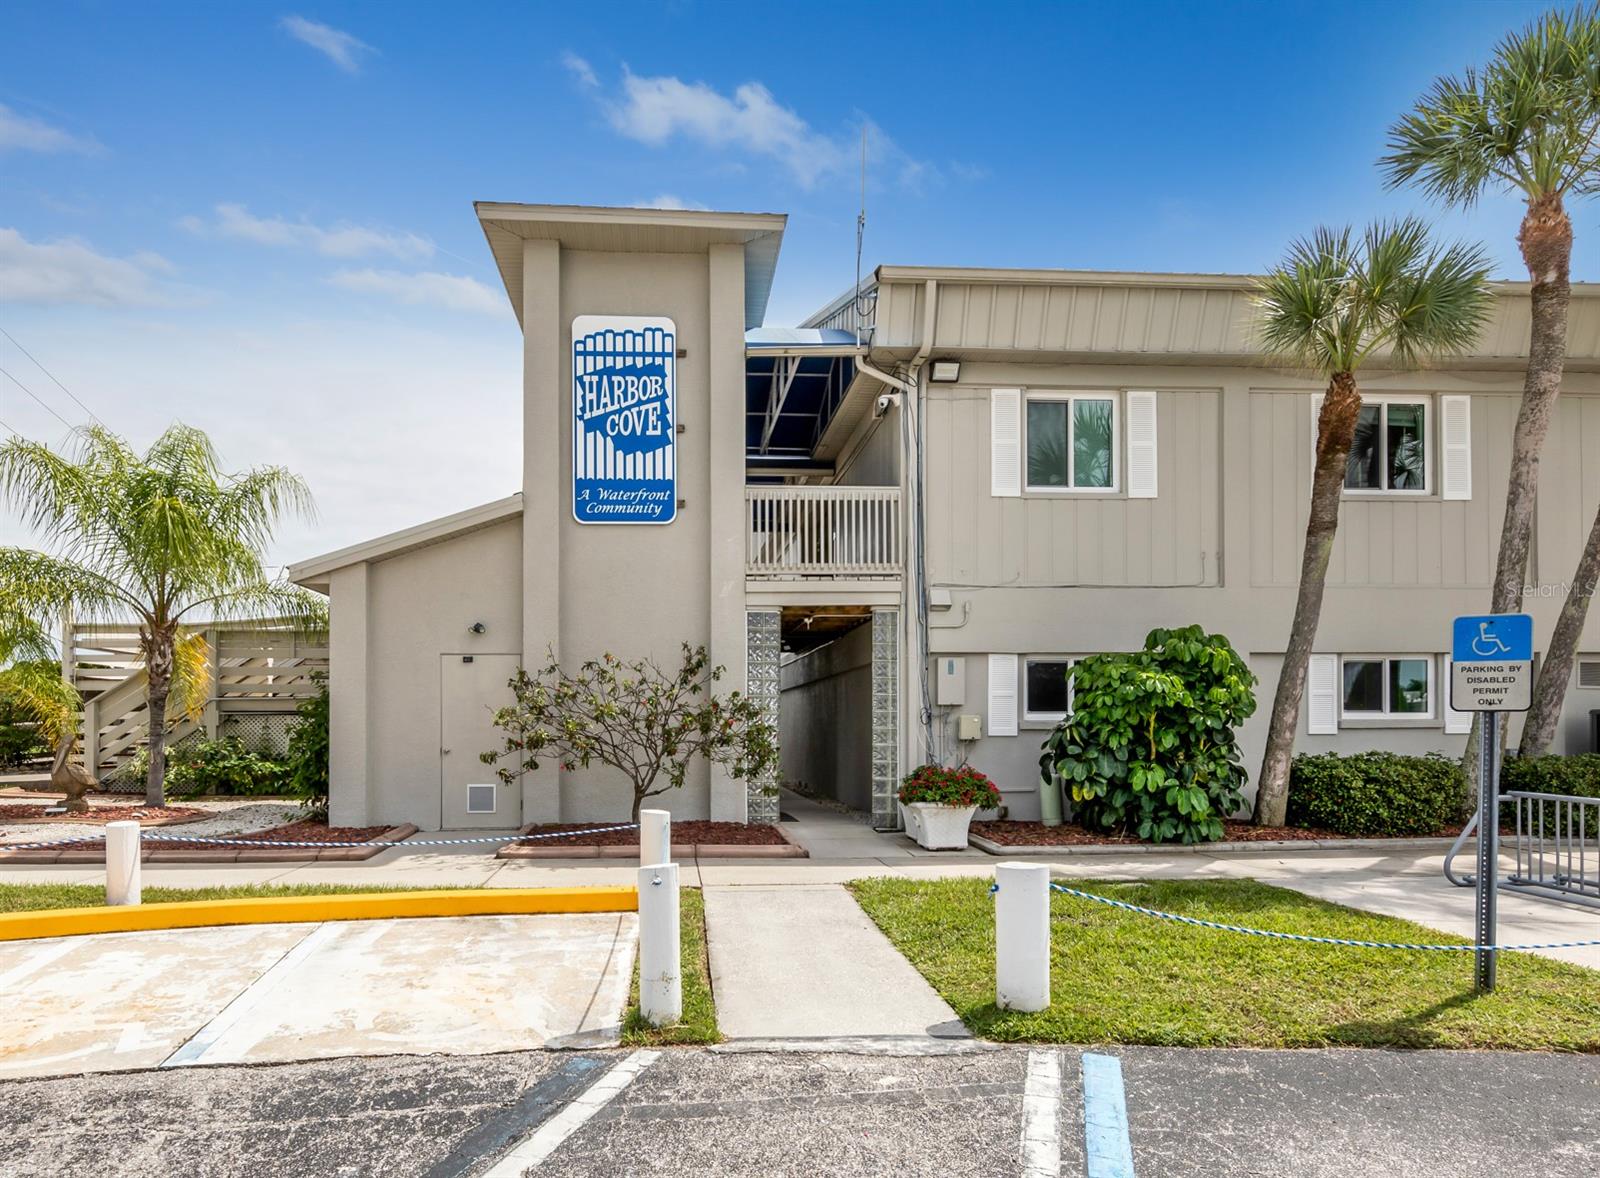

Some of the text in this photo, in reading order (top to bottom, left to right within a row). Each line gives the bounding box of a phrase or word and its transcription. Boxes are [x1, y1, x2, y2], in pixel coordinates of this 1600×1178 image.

[583, 375, 664, 420] HARBOR
[606, 401, 662, 436] COVE
[577, 487, 671, 504] A Waterfront
[586, 502, 663, 518] Community
[1460, 665, 1522, 673] PARKING BY
[1466, 676, 1516, 684] DISABLED
[1472, 687, 1509, 695] PERMIT
[1477, 698, 1504, 706] ONLY
